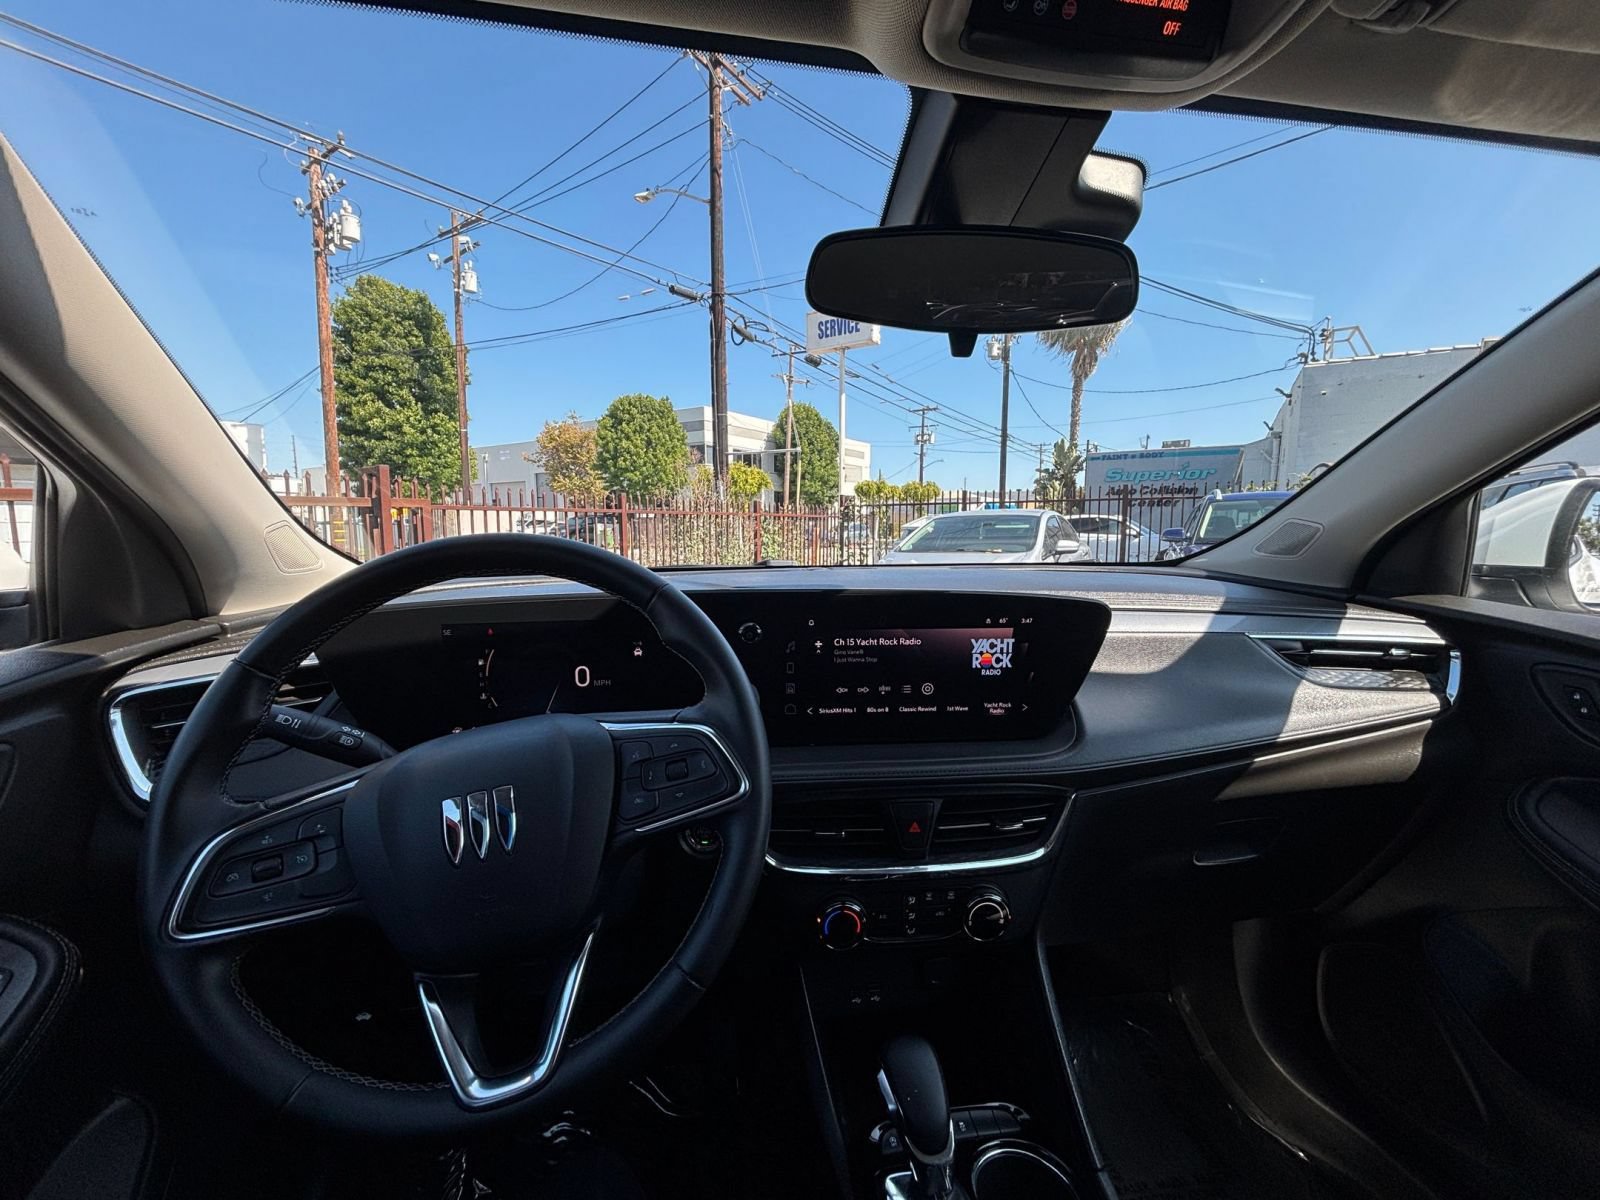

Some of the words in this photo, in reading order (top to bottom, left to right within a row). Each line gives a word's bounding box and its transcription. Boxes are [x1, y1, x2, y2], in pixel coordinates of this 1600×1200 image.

[1163, 20, 1182, 35] OFF
[818, 319, 861, 340] SERVICE
[1104, 462, 1217, 484] Superior
[1105, 486, 1137, 496] Auo
[833, 638, 845, 646] Ch
[846, 638, 855, 646] 15
[856, 637, 878, 646] Yacht
[879, 637, 898, 646] Rock
[899, 637, 922, 646] Radio
[970, 638, 1016, 653] YACHT
[971, 652, 1013, 669] ROCK
[574, 665, 591, 687] 0
[981, 668, 1002, 676] RADIO
[593, 678, 612, 687] MPH
